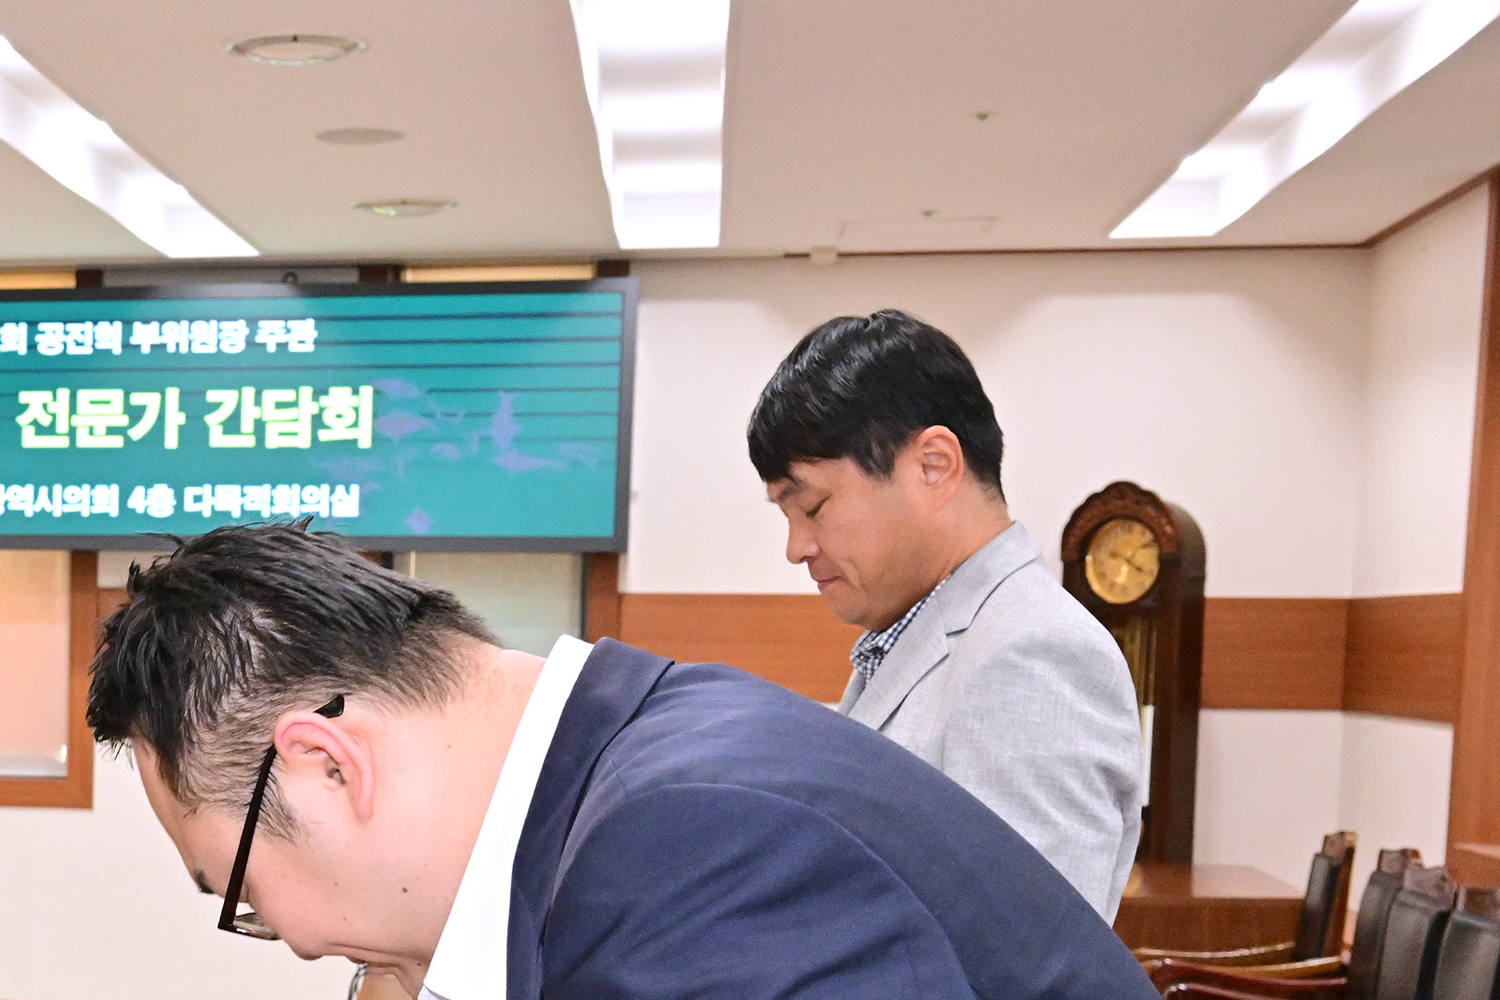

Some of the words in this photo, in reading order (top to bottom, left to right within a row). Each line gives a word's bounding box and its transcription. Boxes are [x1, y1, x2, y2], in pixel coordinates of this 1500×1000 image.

[130, 319, 249, 354] 부위원장
[255, 319, 318, 352] 주관
[15, 387, 186, 449] 전문가
[203, 385, 374, 449] 간담회
[127, 484, 176, 517] 4층
[183, 483, 360, 518] 다목적회의실
